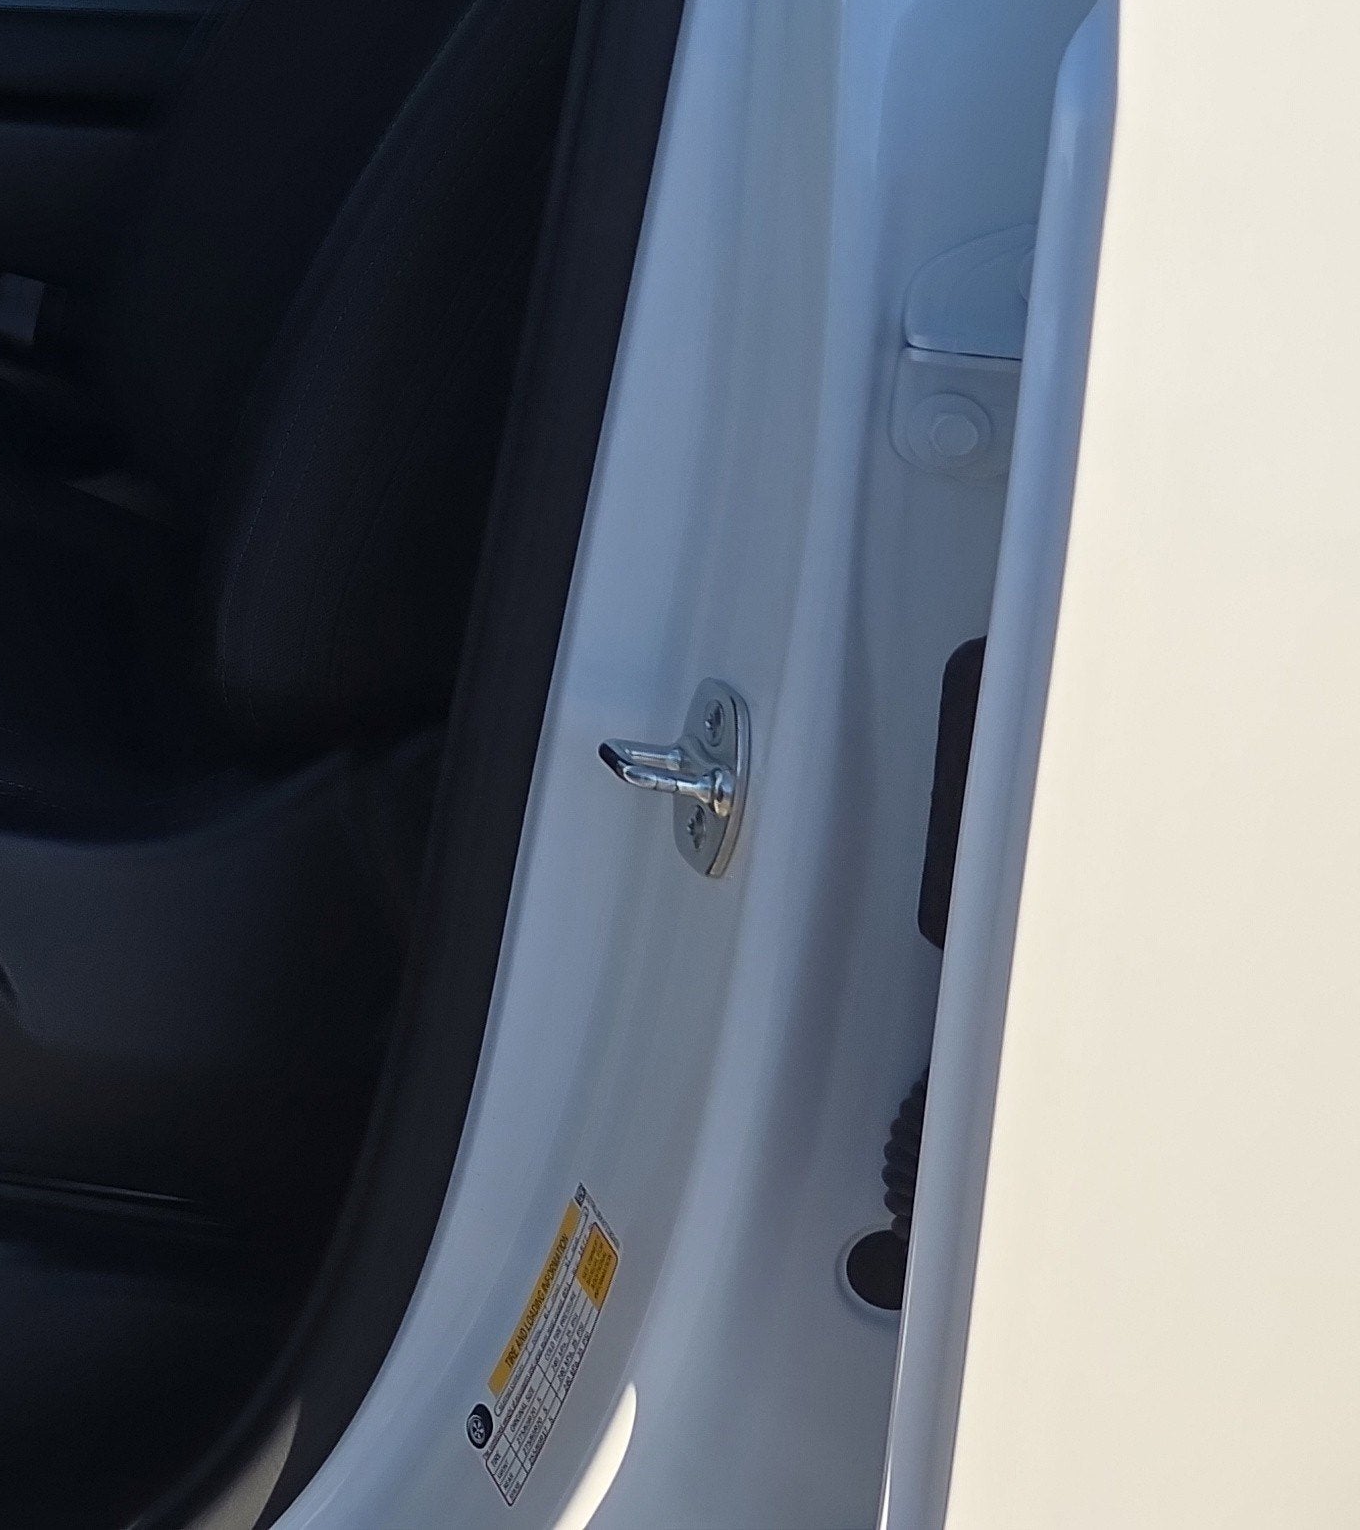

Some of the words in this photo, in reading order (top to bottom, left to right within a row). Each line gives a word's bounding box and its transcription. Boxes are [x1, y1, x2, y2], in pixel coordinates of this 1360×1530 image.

[504, 1343, 519, 1368] TIRE
[513, 1325, 528, 1350] AND
[522, 1285, 546, 1331] LOADING
[540, 1231, 571, 1294] INFORMATION
